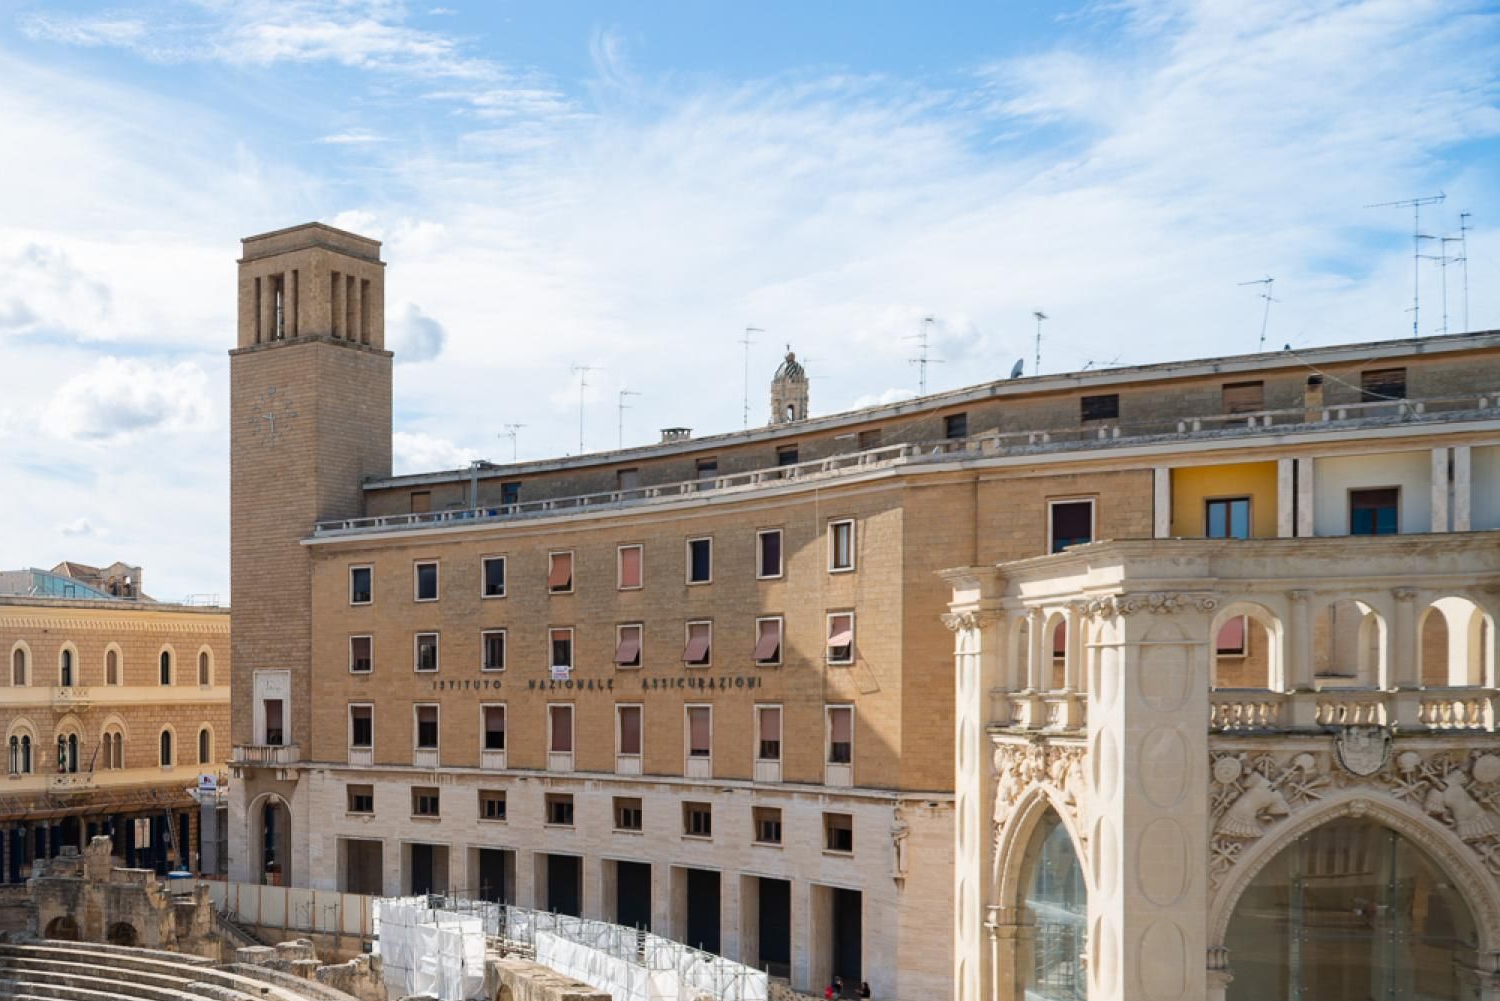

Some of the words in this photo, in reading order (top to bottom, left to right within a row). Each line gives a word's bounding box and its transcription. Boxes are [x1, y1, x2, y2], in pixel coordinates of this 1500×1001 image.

[432, 679, 502, 690] ISTITUTO
[528, 678, 614, 690] NAZIONALE
[642, 676, 762, 689] ASSICURAZIONI
